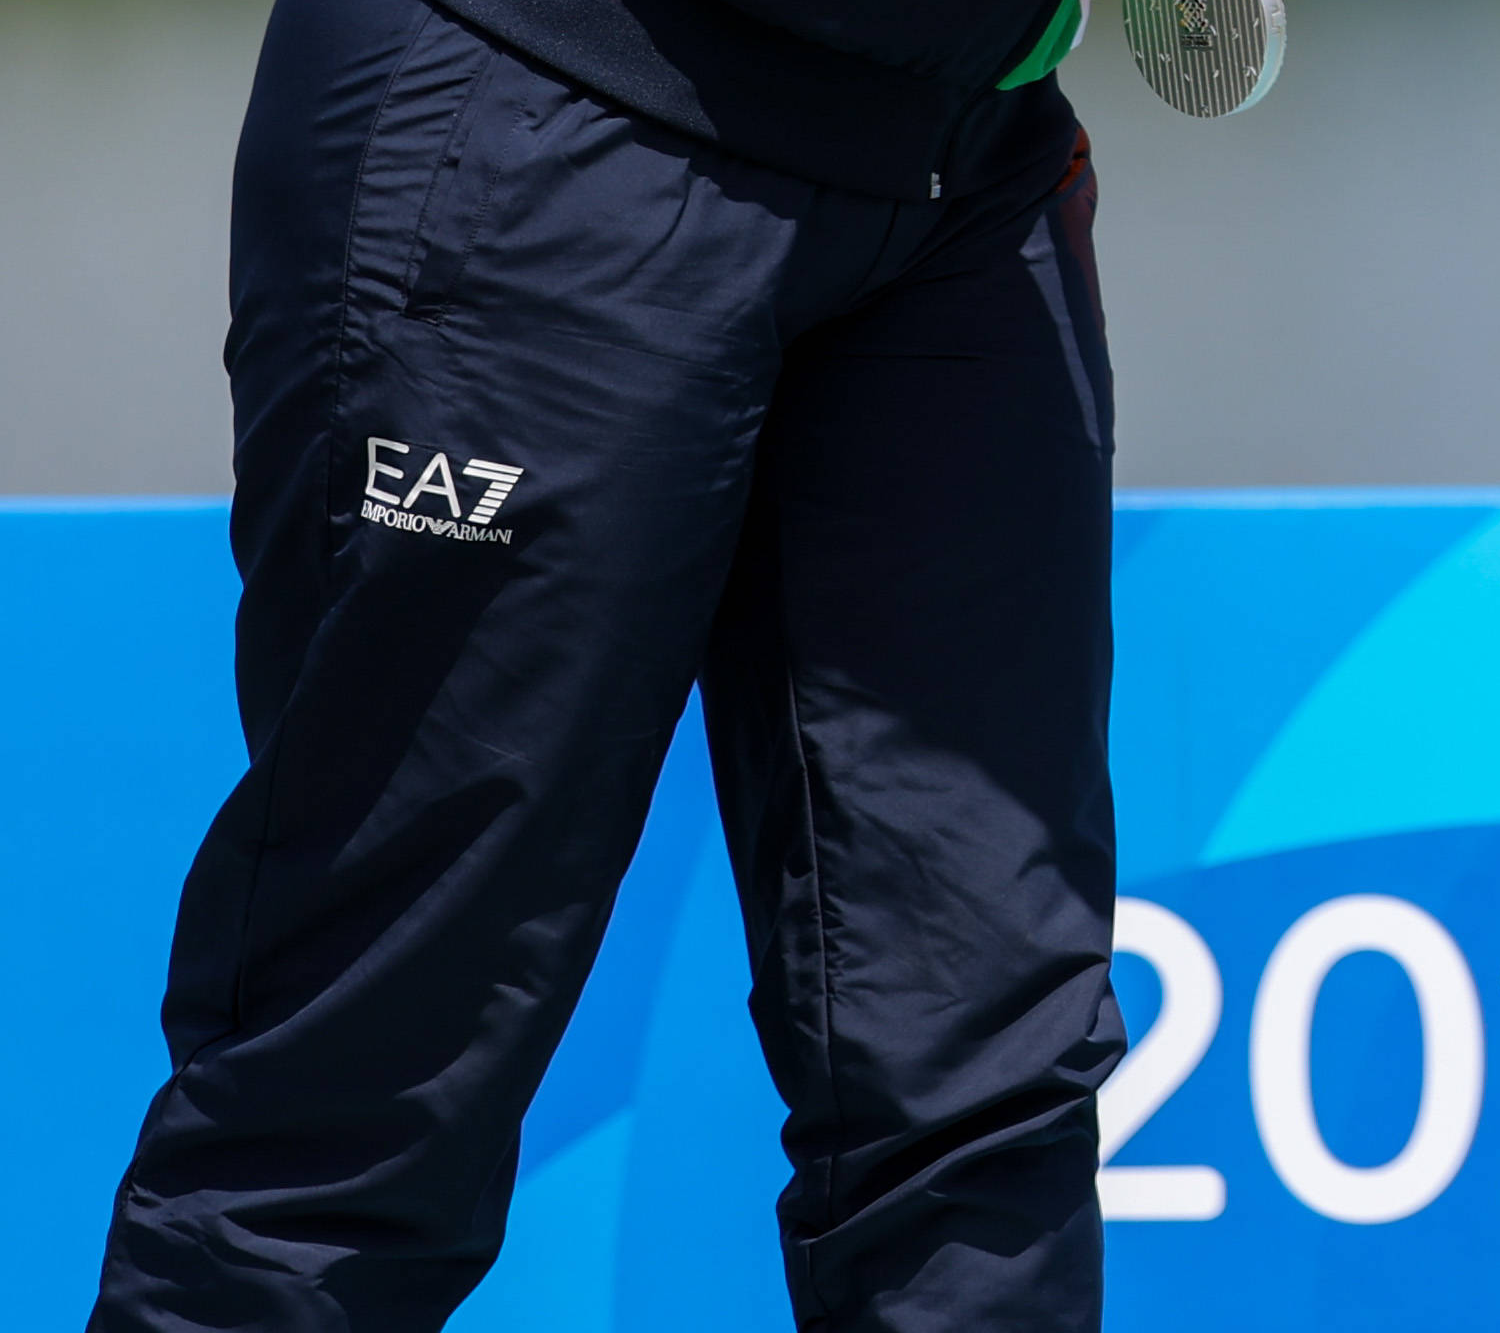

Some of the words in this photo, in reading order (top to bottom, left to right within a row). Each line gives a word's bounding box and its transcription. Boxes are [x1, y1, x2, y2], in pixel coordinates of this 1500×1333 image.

[364, 436, 525, 525] EA7
[360, 499, 427, 533] EMPORIO
[445, 520, 513, 545] ARMANI
